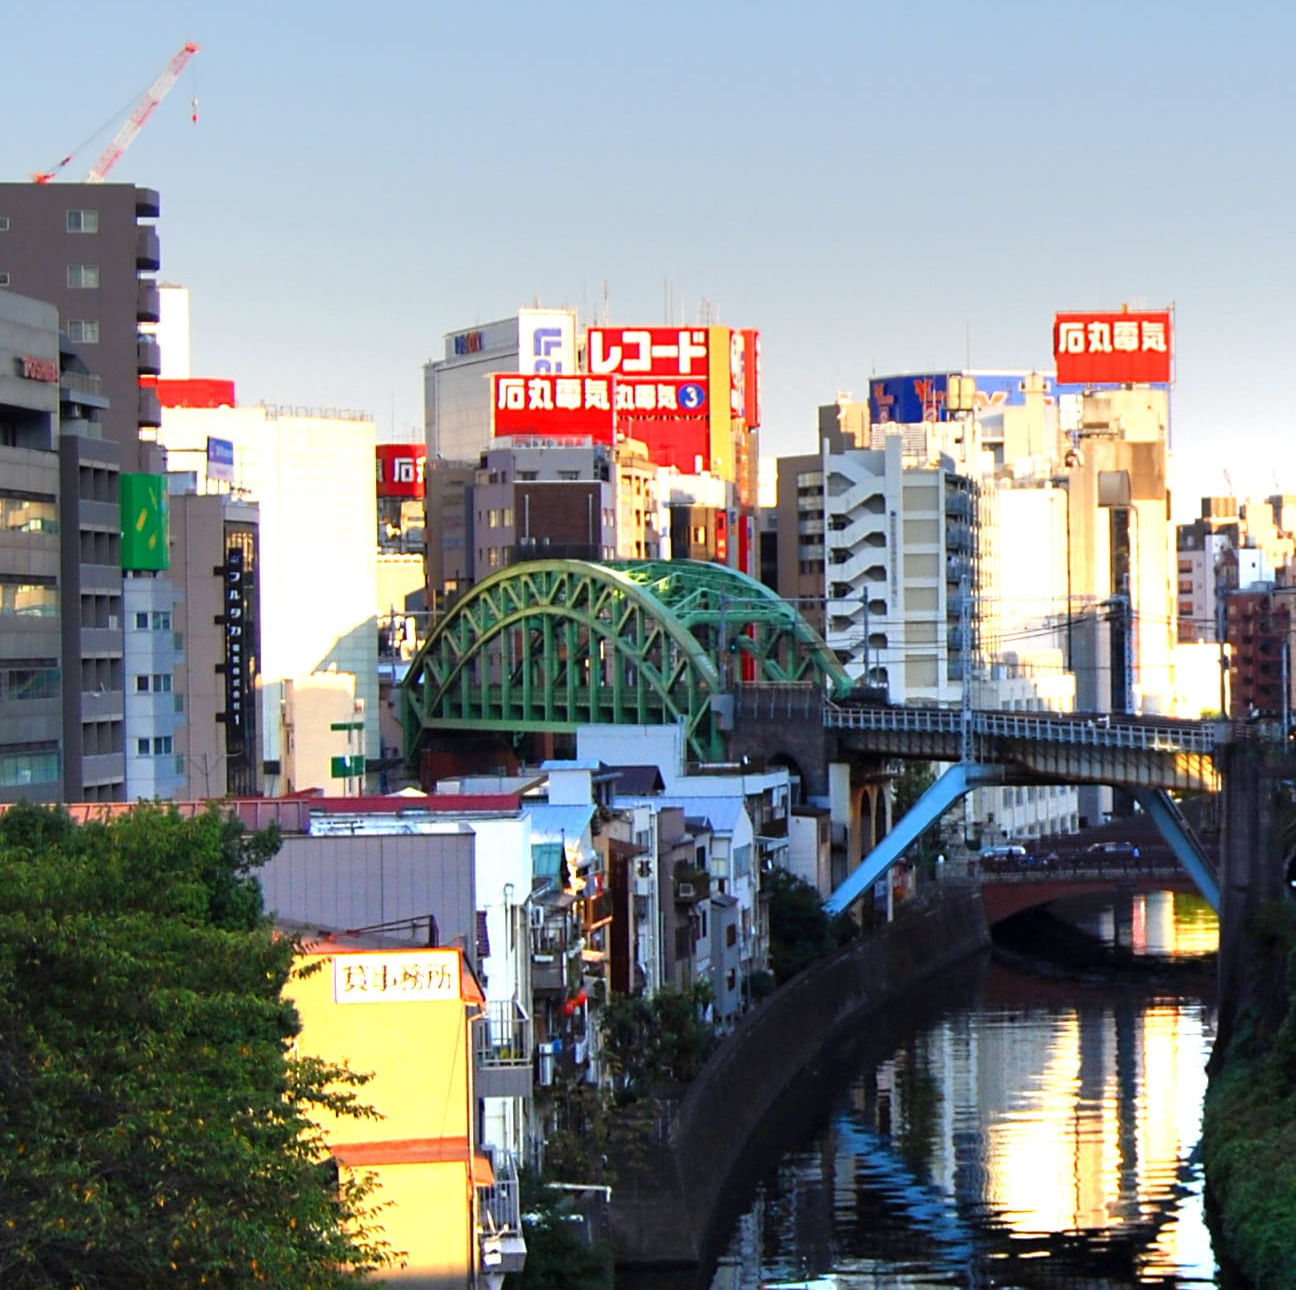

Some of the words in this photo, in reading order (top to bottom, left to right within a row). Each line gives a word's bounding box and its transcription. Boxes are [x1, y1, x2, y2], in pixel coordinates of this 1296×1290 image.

[590, 331, 708, 373] レコード
[1058, 321, 1168, 354] 石丸電気
[498, 378, 610, 410] 石丸電気
[342, 963, 451, 992] 貸事務所
